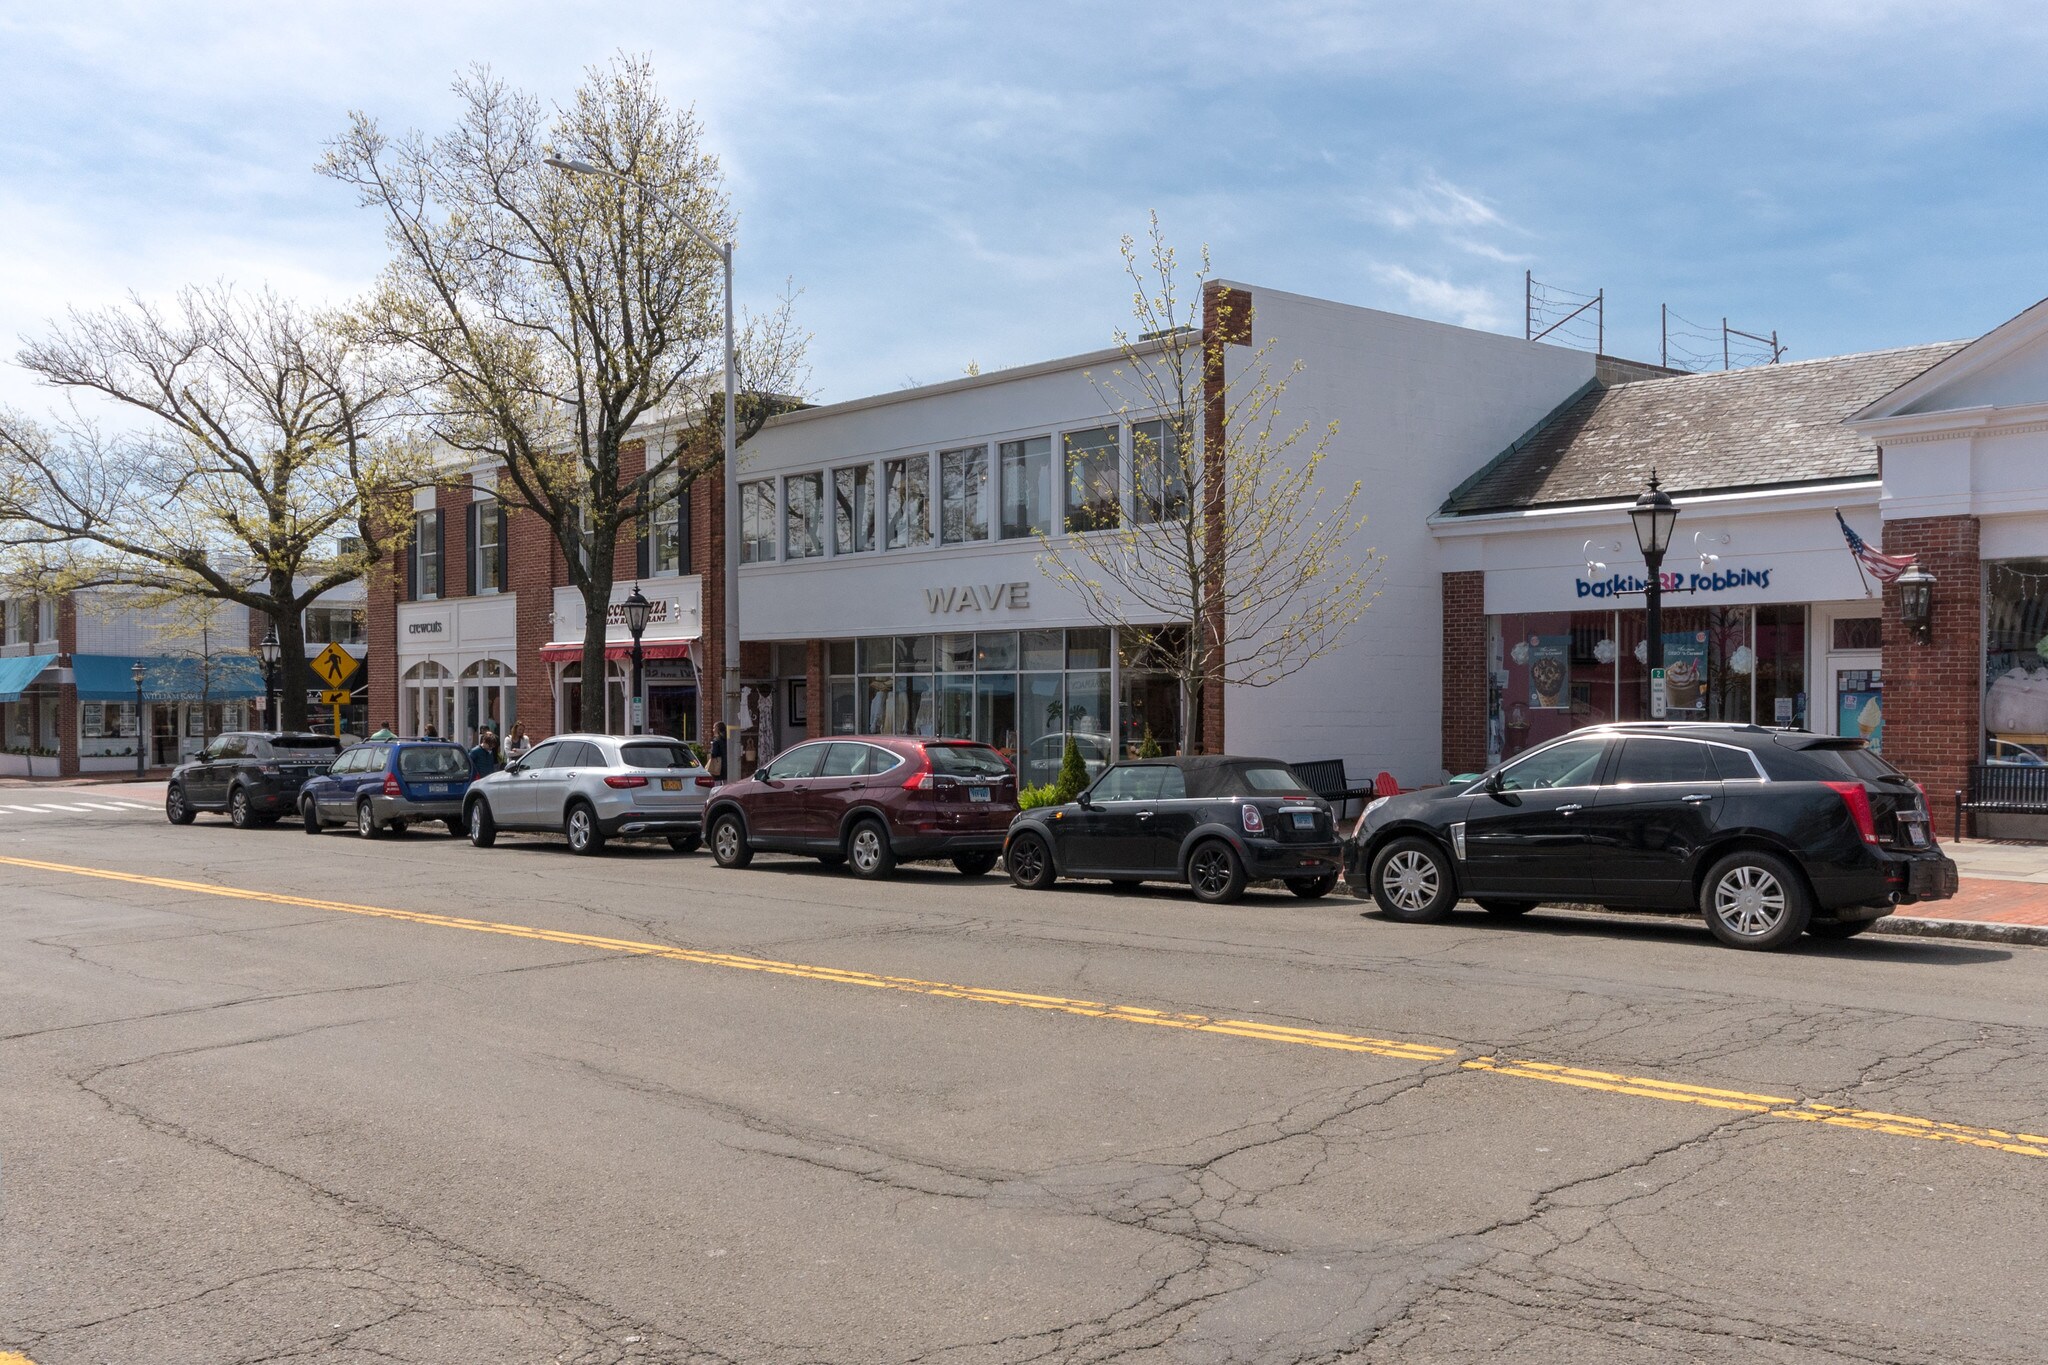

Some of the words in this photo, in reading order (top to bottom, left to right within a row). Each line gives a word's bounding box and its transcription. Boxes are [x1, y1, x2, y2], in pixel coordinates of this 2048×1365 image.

[922, 582, 1030, 613] WAVE
[408, 620, 443, 634] crewcuts
[142, 692, 179, 700] WILLIAM
[180, 692, 204, 700] RAVEI
